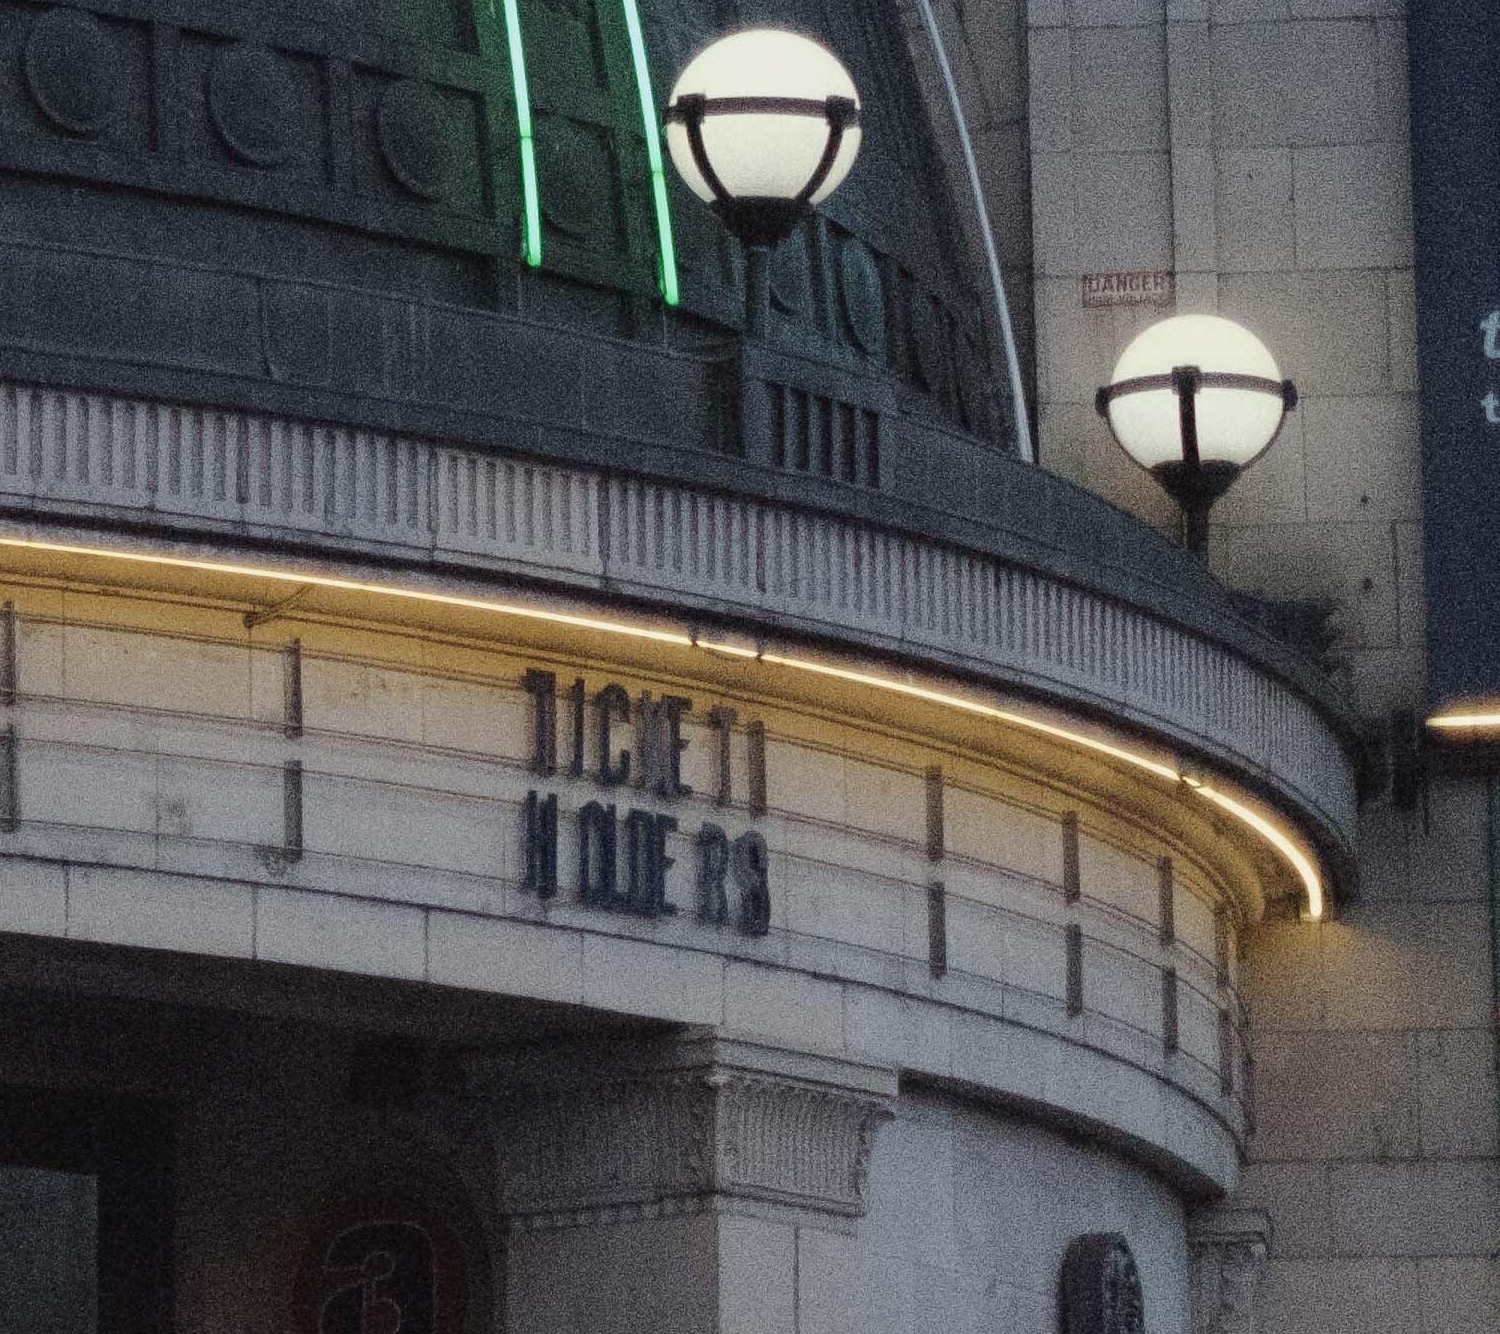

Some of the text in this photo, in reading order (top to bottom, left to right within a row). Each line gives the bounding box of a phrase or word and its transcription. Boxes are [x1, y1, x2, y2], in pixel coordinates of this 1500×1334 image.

[1088, 273, 1165, 292] DANGER
[523, 668, 738, 807] TICKET
[524, 789, 771, 937] HOLDERS
